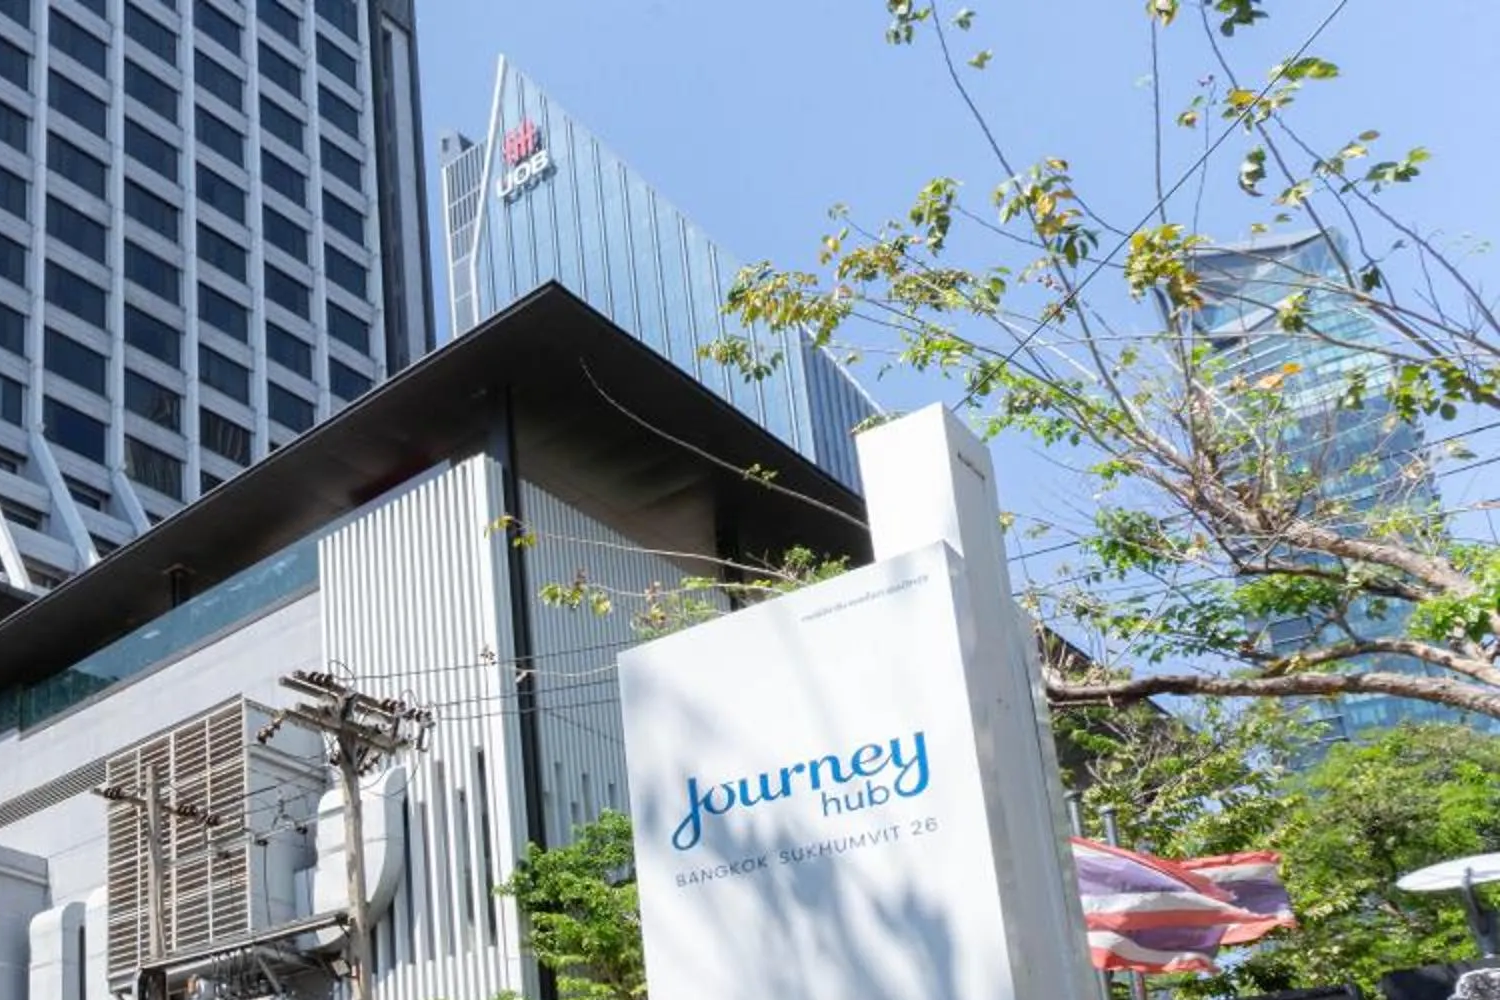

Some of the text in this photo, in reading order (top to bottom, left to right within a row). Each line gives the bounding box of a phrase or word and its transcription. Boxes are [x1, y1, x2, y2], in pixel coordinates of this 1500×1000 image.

[496, 150, 549, 197] UOB
[821, 779, 891, 817] hub
[675, 816, 939, 888] BANGKOK SUKHUMVIT 26
